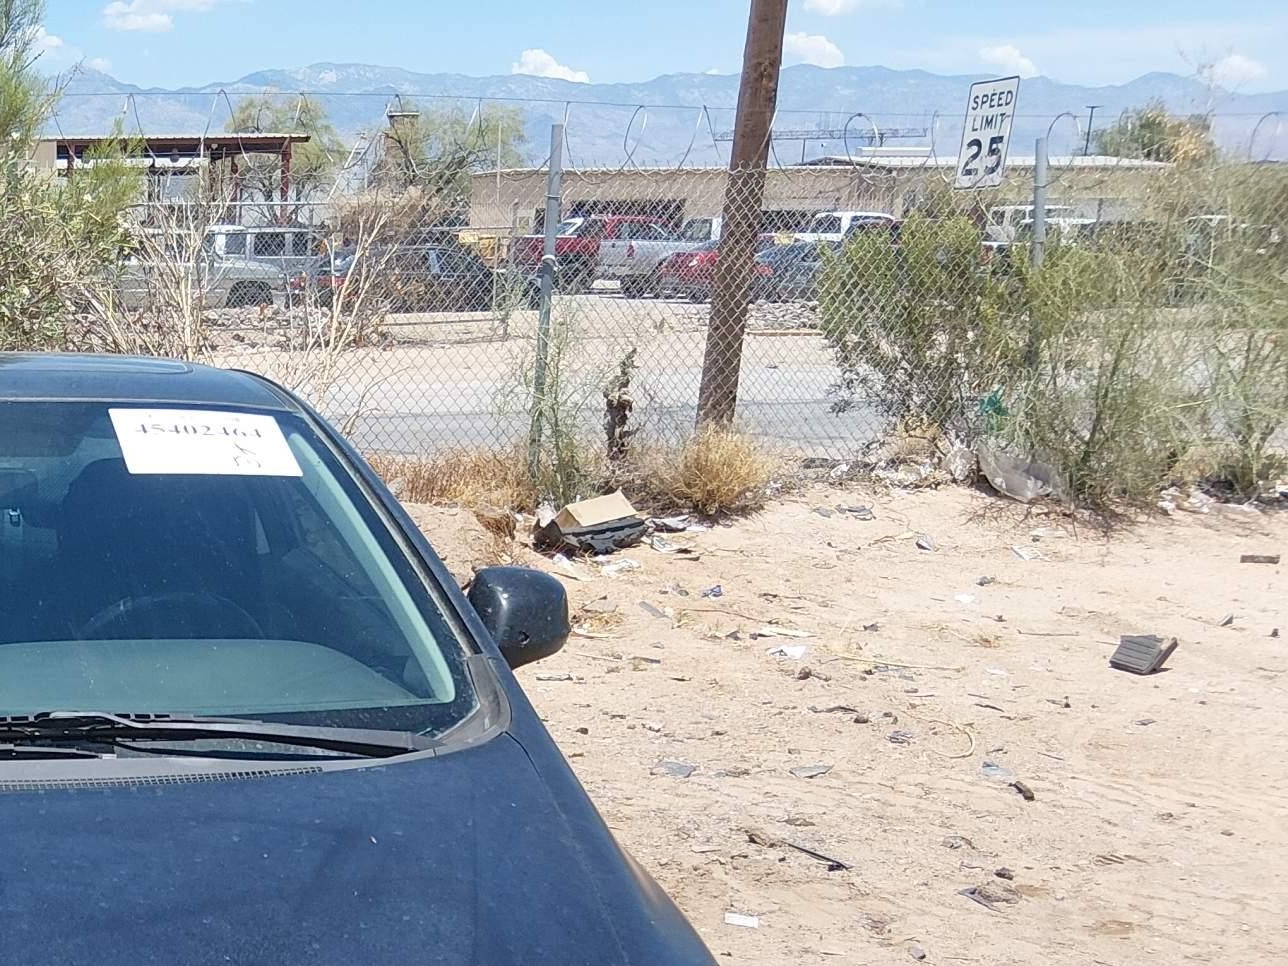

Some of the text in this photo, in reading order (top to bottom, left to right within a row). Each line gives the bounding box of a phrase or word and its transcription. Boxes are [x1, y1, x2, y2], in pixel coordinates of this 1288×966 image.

[971, 90, 1014, 111] SPEED
[972, 113, 1006, 132] LIMIT
[961, 136, 1004, 177] 25
